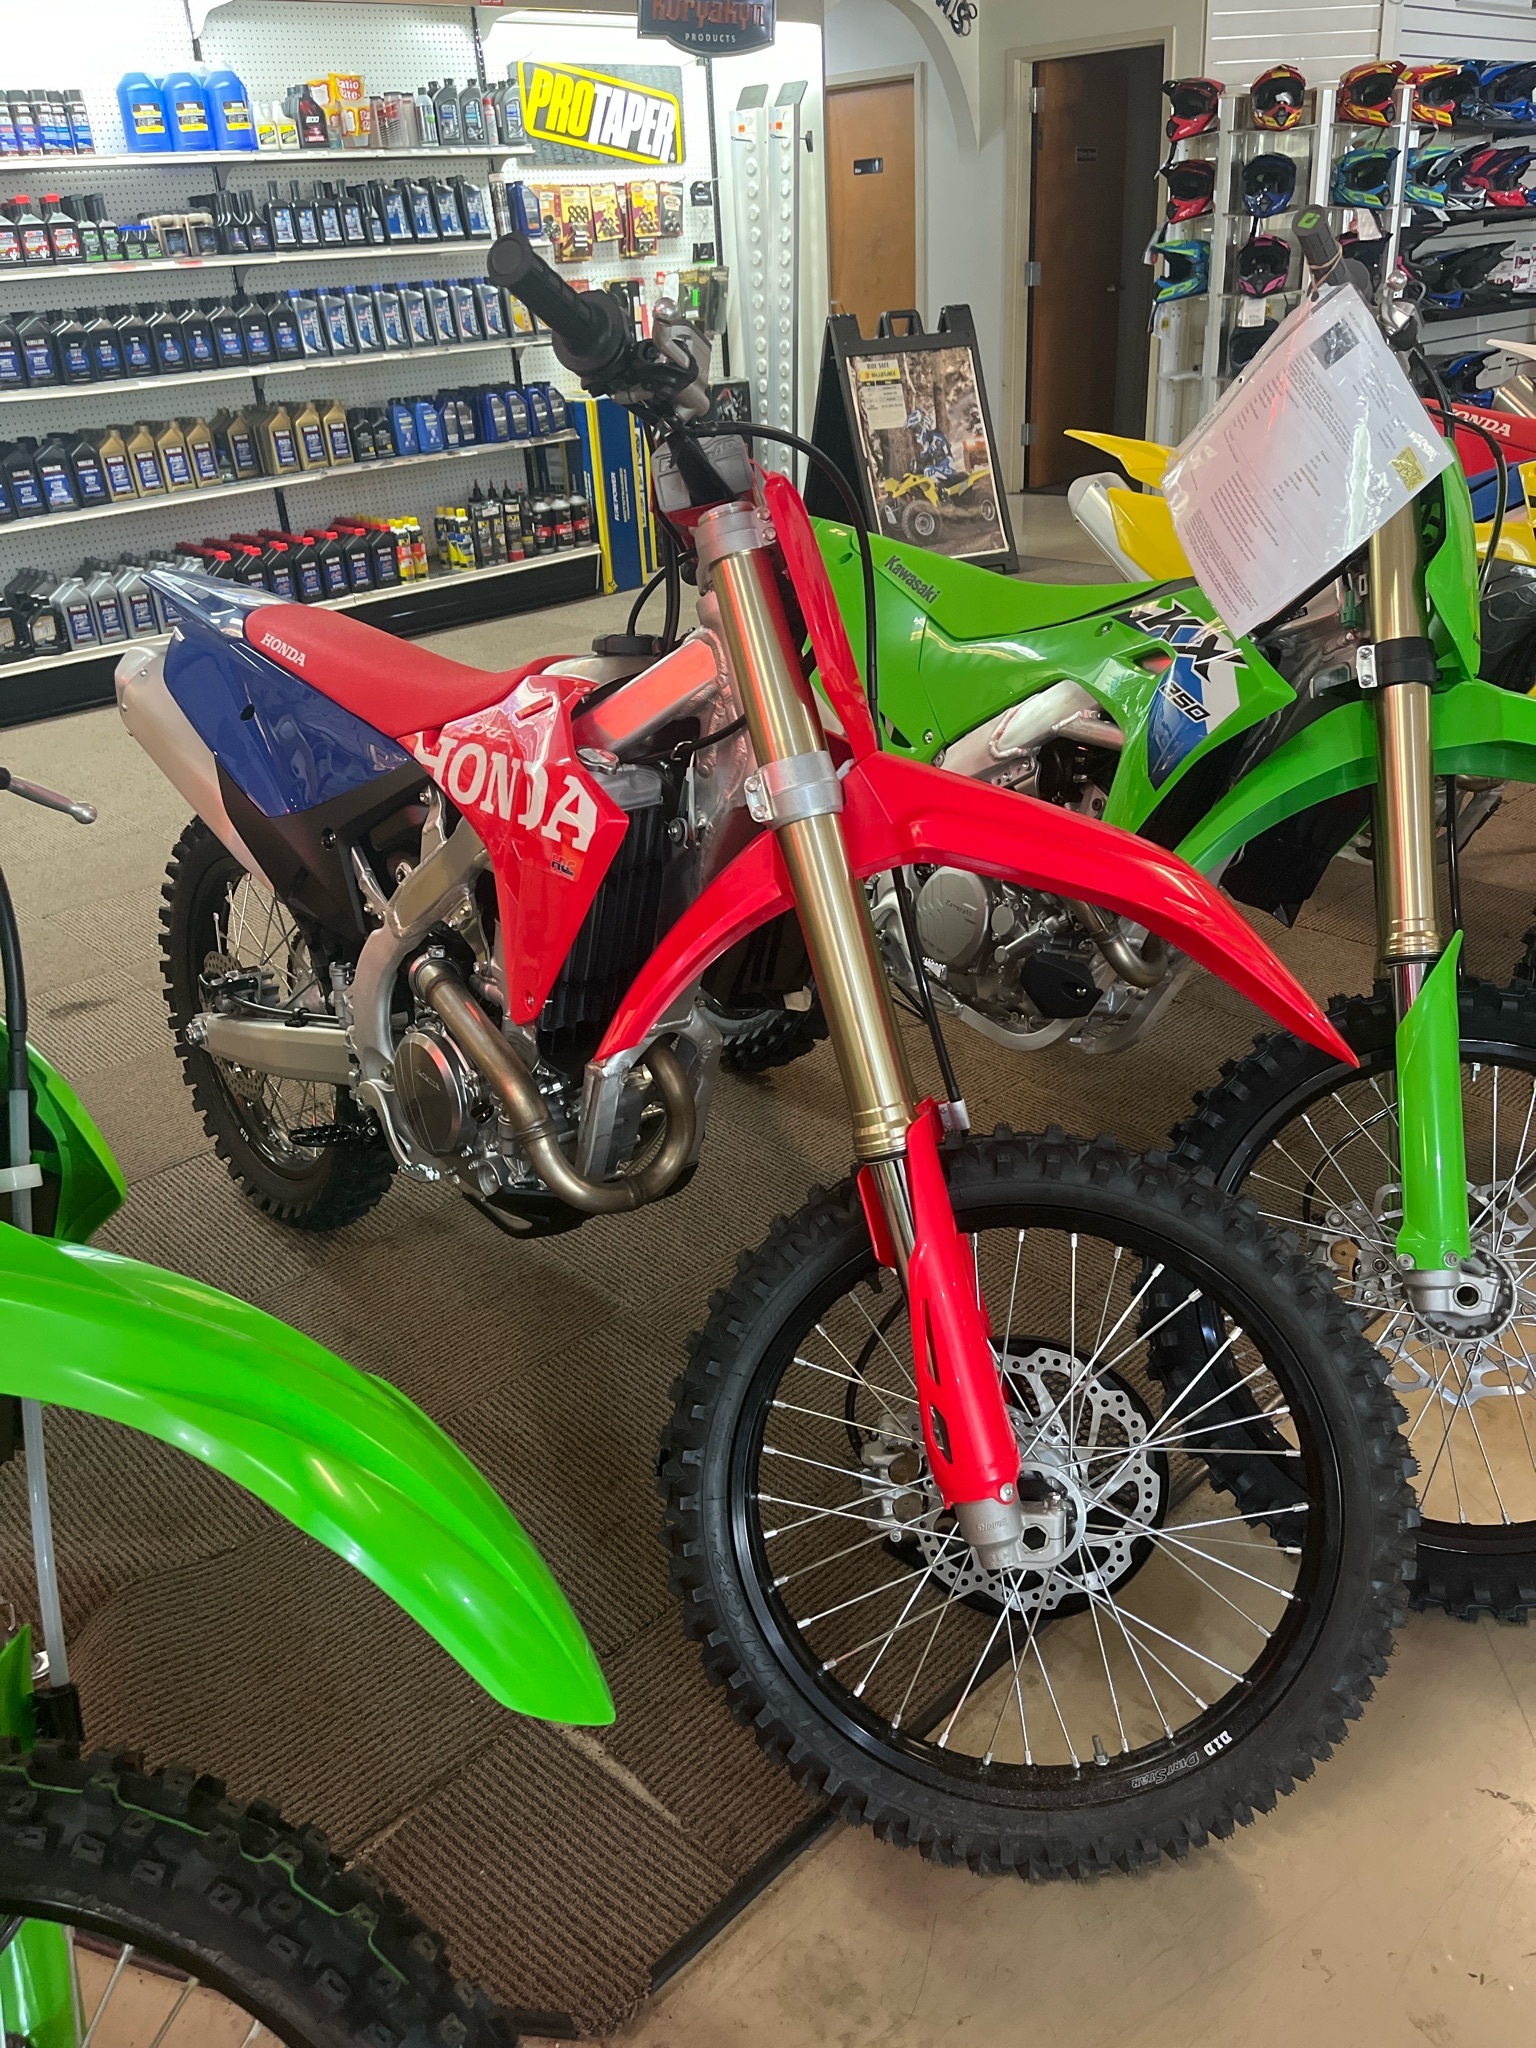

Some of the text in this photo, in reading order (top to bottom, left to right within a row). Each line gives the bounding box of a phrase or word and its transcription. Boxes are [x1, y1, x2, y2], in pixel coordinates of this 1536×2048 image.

[685, 33, 736, 43] PRODUCTS
[884, 555, 941, 604] Kawasaki
[260, 632, 306, 667] HONDA
[1139, 602, 1248, 683] KX
[1160, 682, 1211, 722] 250
[413, 732, 598, 852] HONDA
